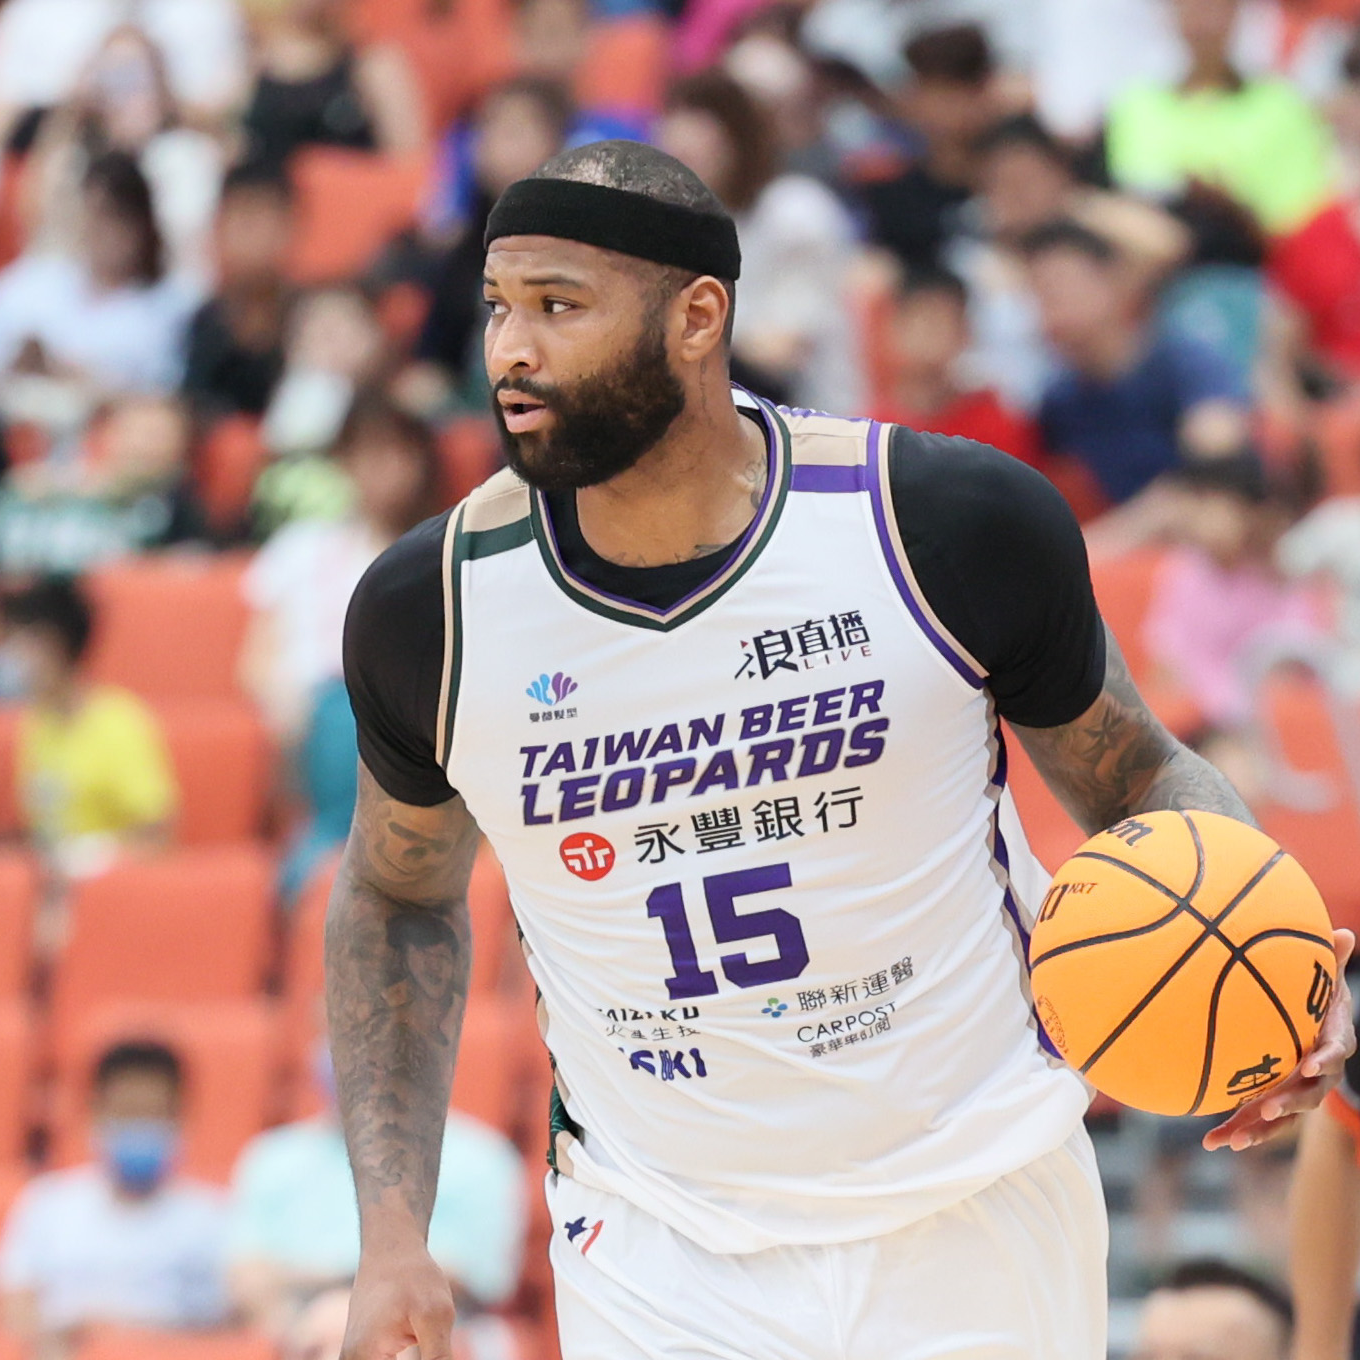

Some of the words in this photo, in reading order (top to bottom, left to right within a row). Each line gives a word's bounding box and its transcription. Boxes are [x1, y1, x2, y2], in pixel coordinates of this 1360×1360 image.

[734, 609, 871, 680] 浪直播
[804, 645, 872, 670] LIVE
[519, 713, 725, 778] TAIWAN
[738, 679, 885, 741] BEER
[520, 717, 890, 826] LEOPARDS
[633, 786, 864, 864] 永豐銀行
[646, 862, 810, 1000] 15
[797, 1001, 897, 1043] CARPOST
